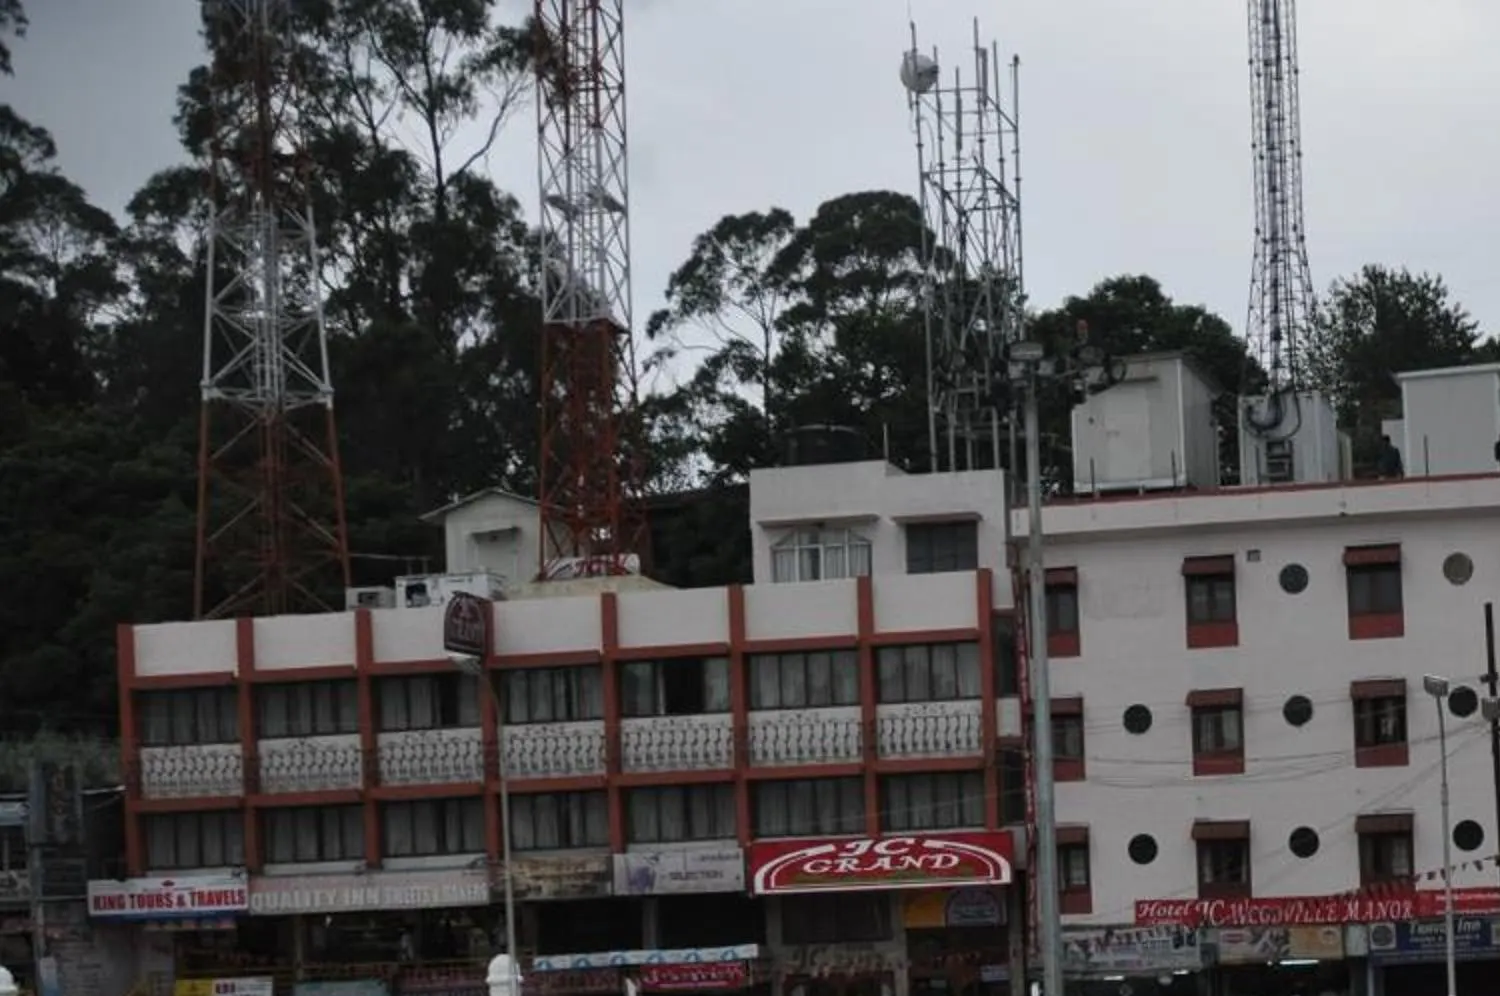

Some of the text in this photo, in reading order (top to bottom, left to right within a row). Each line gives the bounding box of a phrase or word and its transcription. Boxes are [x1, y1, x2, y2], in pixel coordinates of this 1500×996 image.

[802, 853, 961, 874] GRAND
[93, 893, 125, 910] KING
[189, 888, 246, 907] TRAVELS
[251, 888, 337, 912] QUALITY
[1137, 901, 1190, 918] Hotel
[1342, 899, 1413, 921] MANOR
